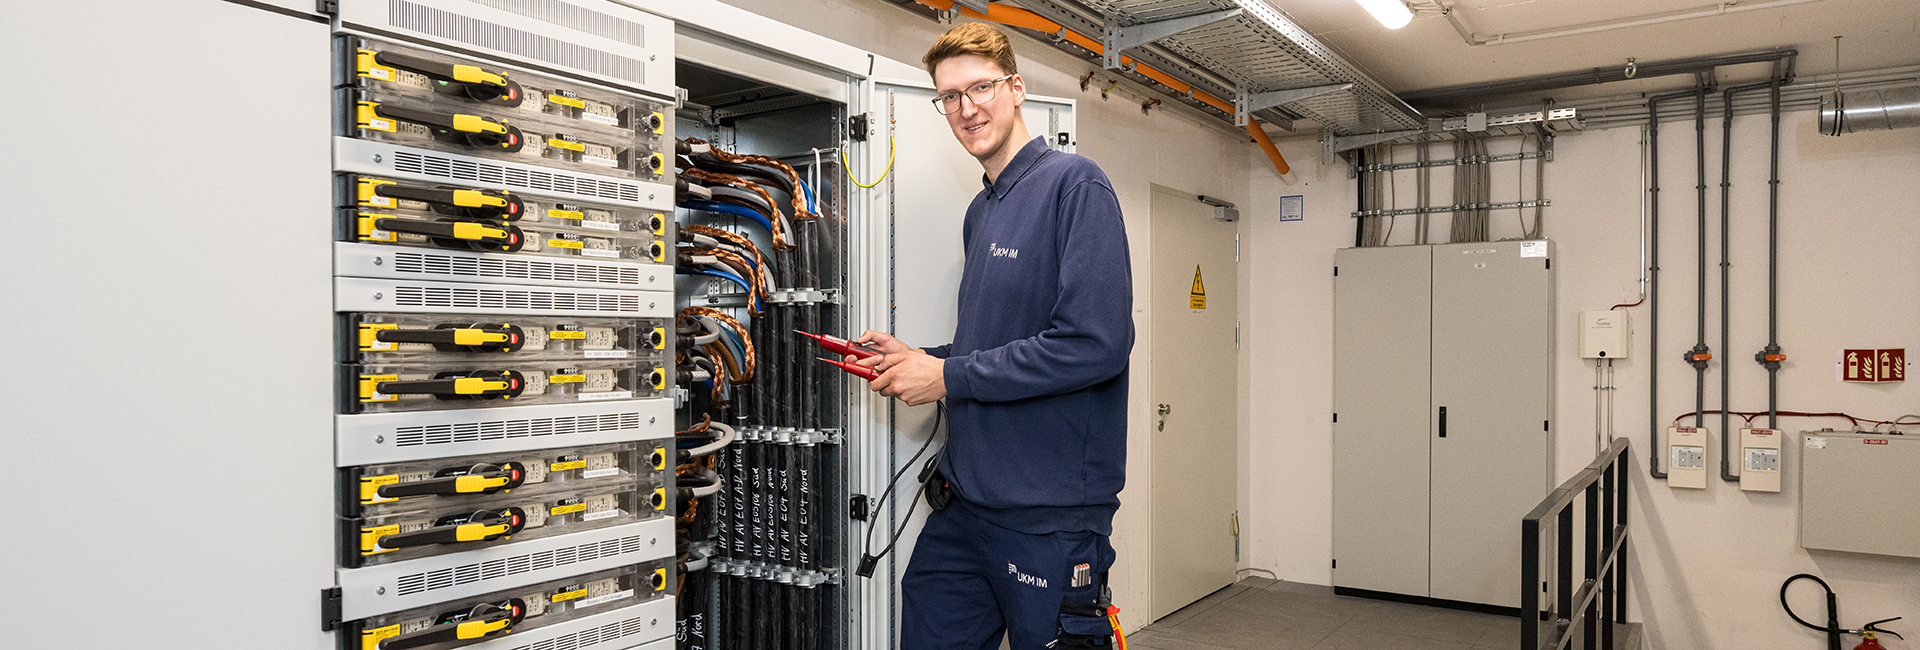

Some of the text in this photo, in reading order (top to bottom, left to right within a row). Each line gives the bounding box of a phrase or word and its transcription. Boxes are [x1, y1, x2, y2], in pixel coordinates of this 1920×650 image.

[993, 247, 1009, 258] UKM
[734, 448, 742, 472] Nord
[800, 468, 808, 494] Nord
[736, 520, 744, 536] AV
[753, 524, 762, 538] AV
[768, 526, 774, 540] AV
[782, 527, 790, 542] AV
[719, 534, 727, 549] HV
[736, 537, 744, 552] HV
[800, 530, 808, 547] AV
[754, 542, 762, 557] HV
[768, 542, 776, 558] HV
[782, 544, 791, 561] HV
[800, 548, 809, 564] HV
[1017, 572, 1048, 588] UKM IM
[676, 618, 688, 642] Süd
[690, 612, 704, 638] Nord
